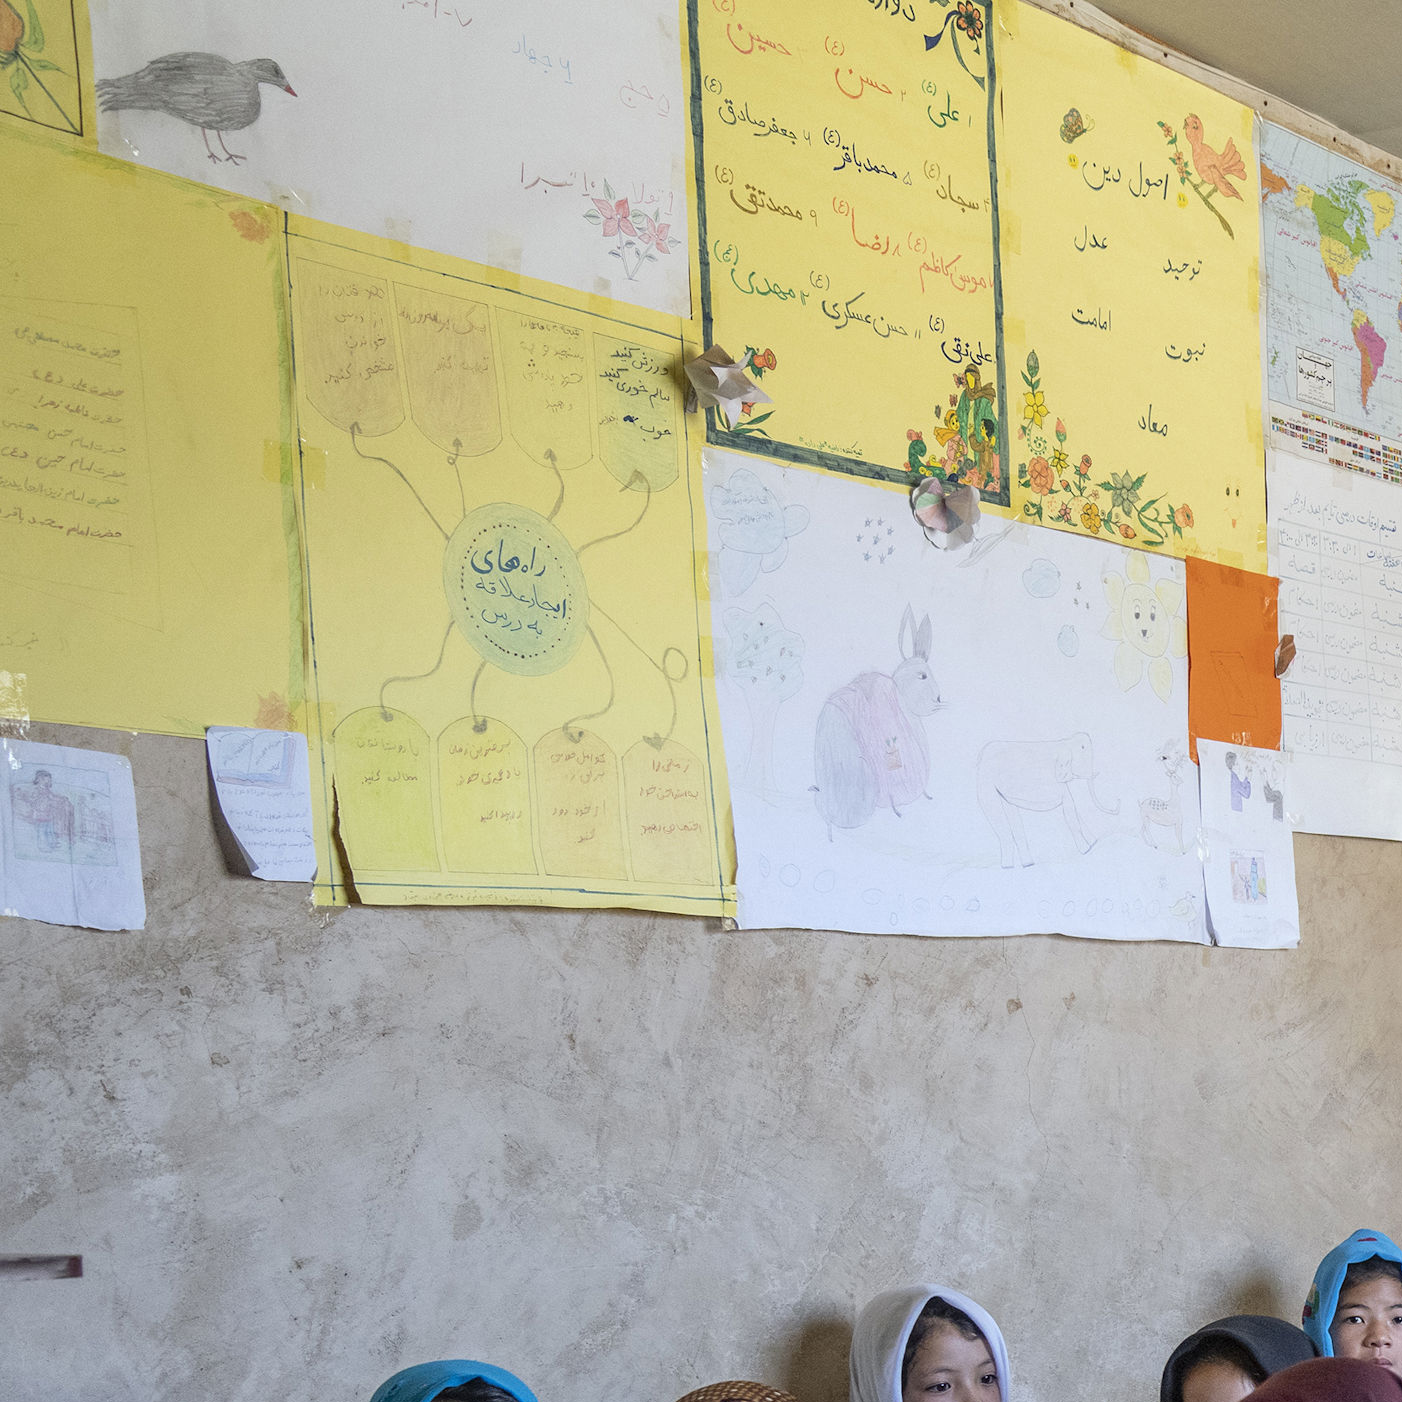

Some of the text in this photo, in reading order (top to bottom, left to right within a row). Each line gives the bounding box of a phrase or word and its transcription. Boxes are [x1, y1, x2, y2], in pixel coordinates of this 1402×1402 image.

[726, 23, 792, 55] حسین
[834, 67, 893, 99] حسن
[928, 91, 960, 128] علی
[936, 174, 980, 214] سجاد
[1082, 161, 1169, 200] اصول دین
[1073, 224, 1108, 252] عدل
[731, 268, 796, 301] مهدی
[821, 291, 873, 330] عسکری
[1071, 306, 1112, 331] امامت
[1164, 342, 1207, 363] نبوت
[1137, 403, 1169, 437] معاد
[475, 576, 567, 620] ایجاد علاقه
[481, 609, 543, 640] به درس
